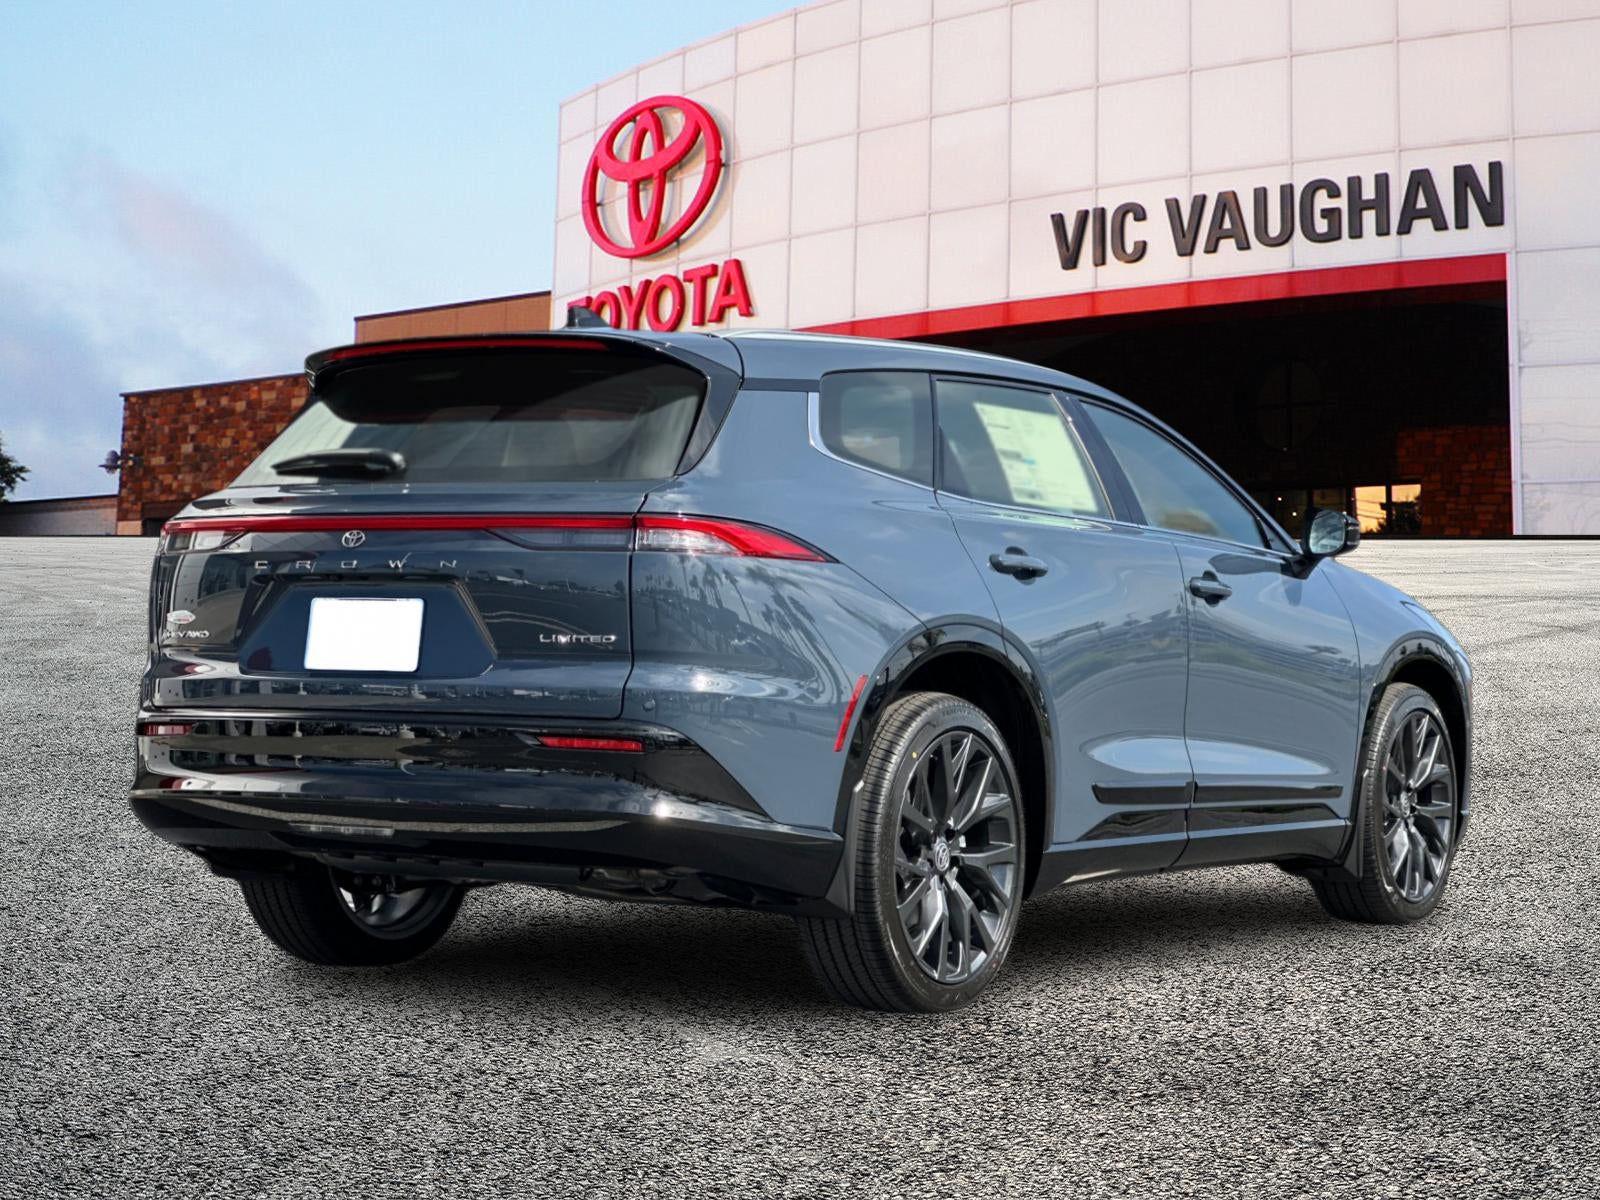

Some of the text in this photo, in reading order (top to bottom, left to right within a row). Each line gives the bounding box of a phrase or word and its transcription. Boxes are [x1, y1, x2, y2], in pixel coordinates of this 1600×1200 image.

[1050, 160, 1505, 271] VIC VAUGHAN
[253, 559, 458, 570] CROWN
[538, 633, 617, 644] LIMITED
